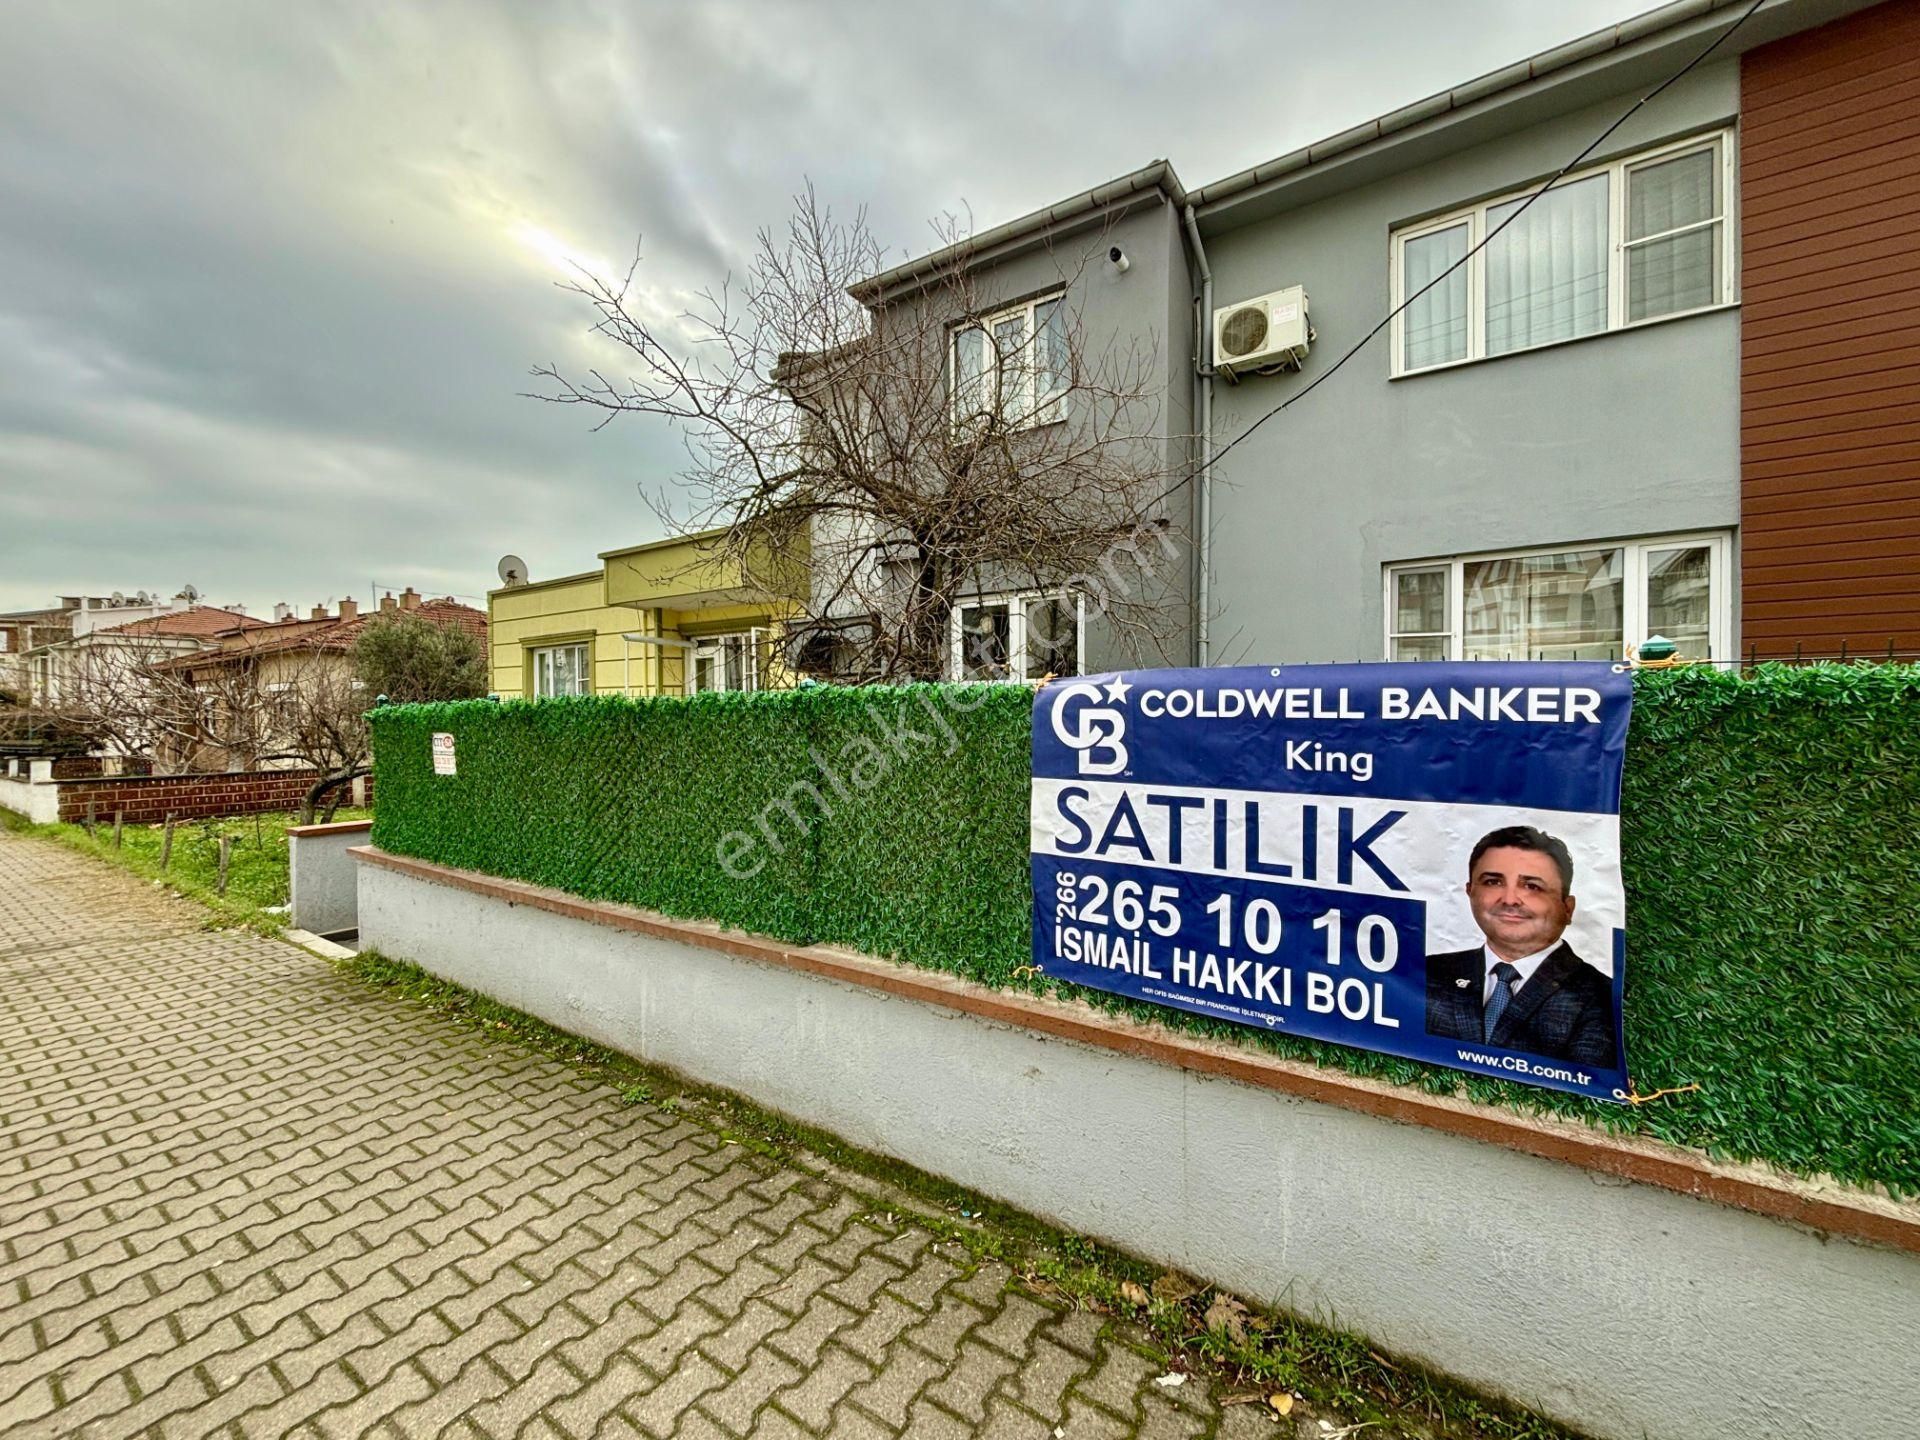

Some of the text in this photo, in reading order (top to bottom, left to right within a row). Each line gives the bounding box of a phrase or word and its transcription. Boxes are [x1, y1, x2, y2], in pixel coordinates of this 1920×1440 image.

[1140, 687, 1601, 724] COLDWELL BANKER
[1286, 740, 1373, 781] King
[1055, 786, 1412, 893] SATILIK
[1056, 871, 1077, 921] 266
[1078, 875, 1399, 973] 265 10 10
[1055, 917, 1399, 1028] İSMAİL HAKKI BOL
[1142, 986, 1154, 995] HER
[1206, 1000, 1240, 1014] FRANCHISE
[1457, 1049, 1592, 1086] www.CB.com.tr
